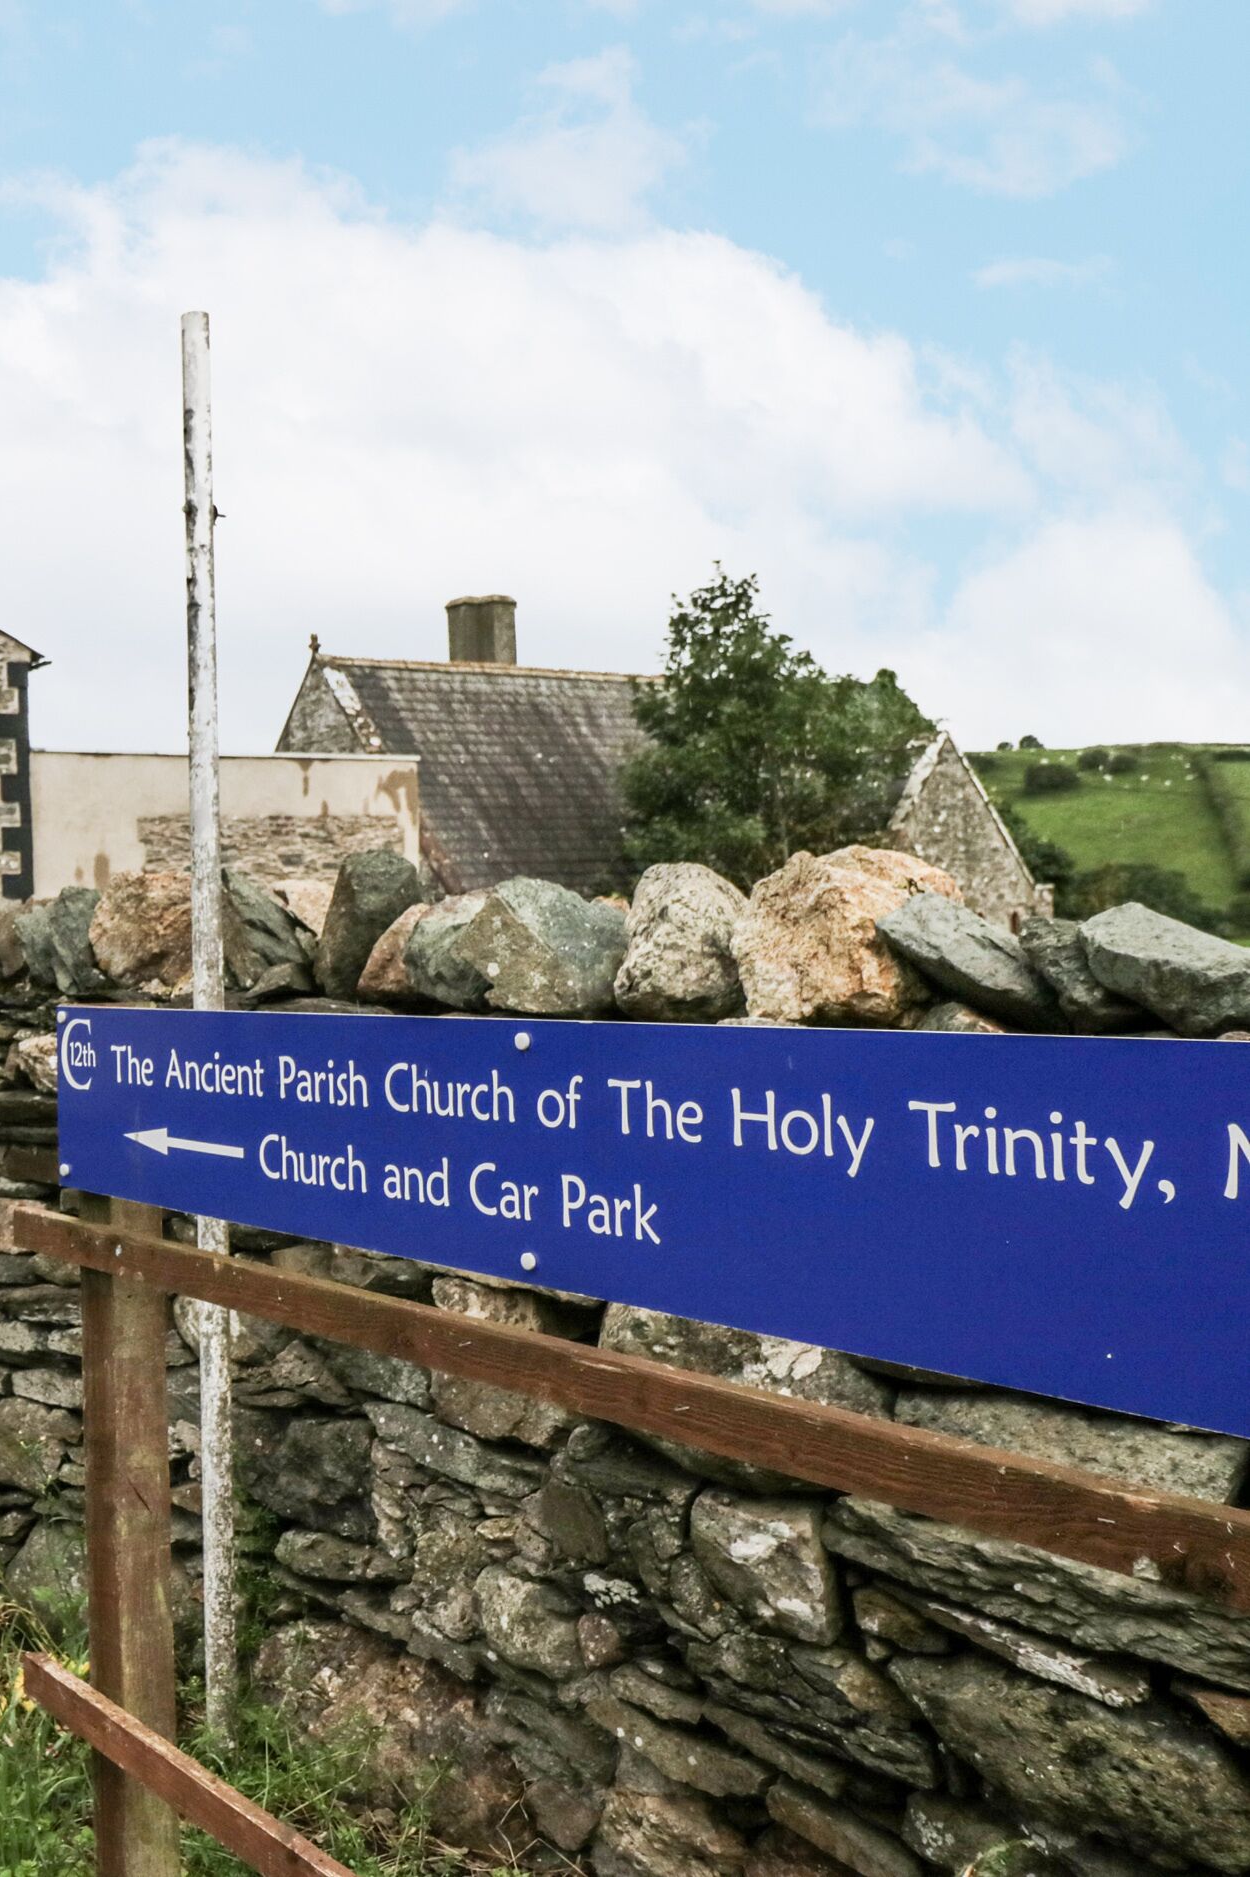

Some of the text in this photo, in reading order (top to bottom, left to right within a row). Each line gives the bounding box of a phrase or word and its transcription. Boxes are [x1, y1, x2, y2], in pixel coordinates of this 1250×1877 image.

[61, 1018, 92, 1090] C
[69, 1042, 96, 1067] 12th
[110, 1045, 154, 1087] The
[165, 1049, 264, 1098] Ancient
[279, 1056, 368, 1107] Parish
[385, 1063, 515, 1123] Church
[537, 1075, 583, 1129] of
[608, 1079, 703, 1143] The
[731, 1088, 874, 1178] Holy
[908, 1101, 1176, 1209] Trinity,
[259, 1134, 661, 1245] Church and Car Park
